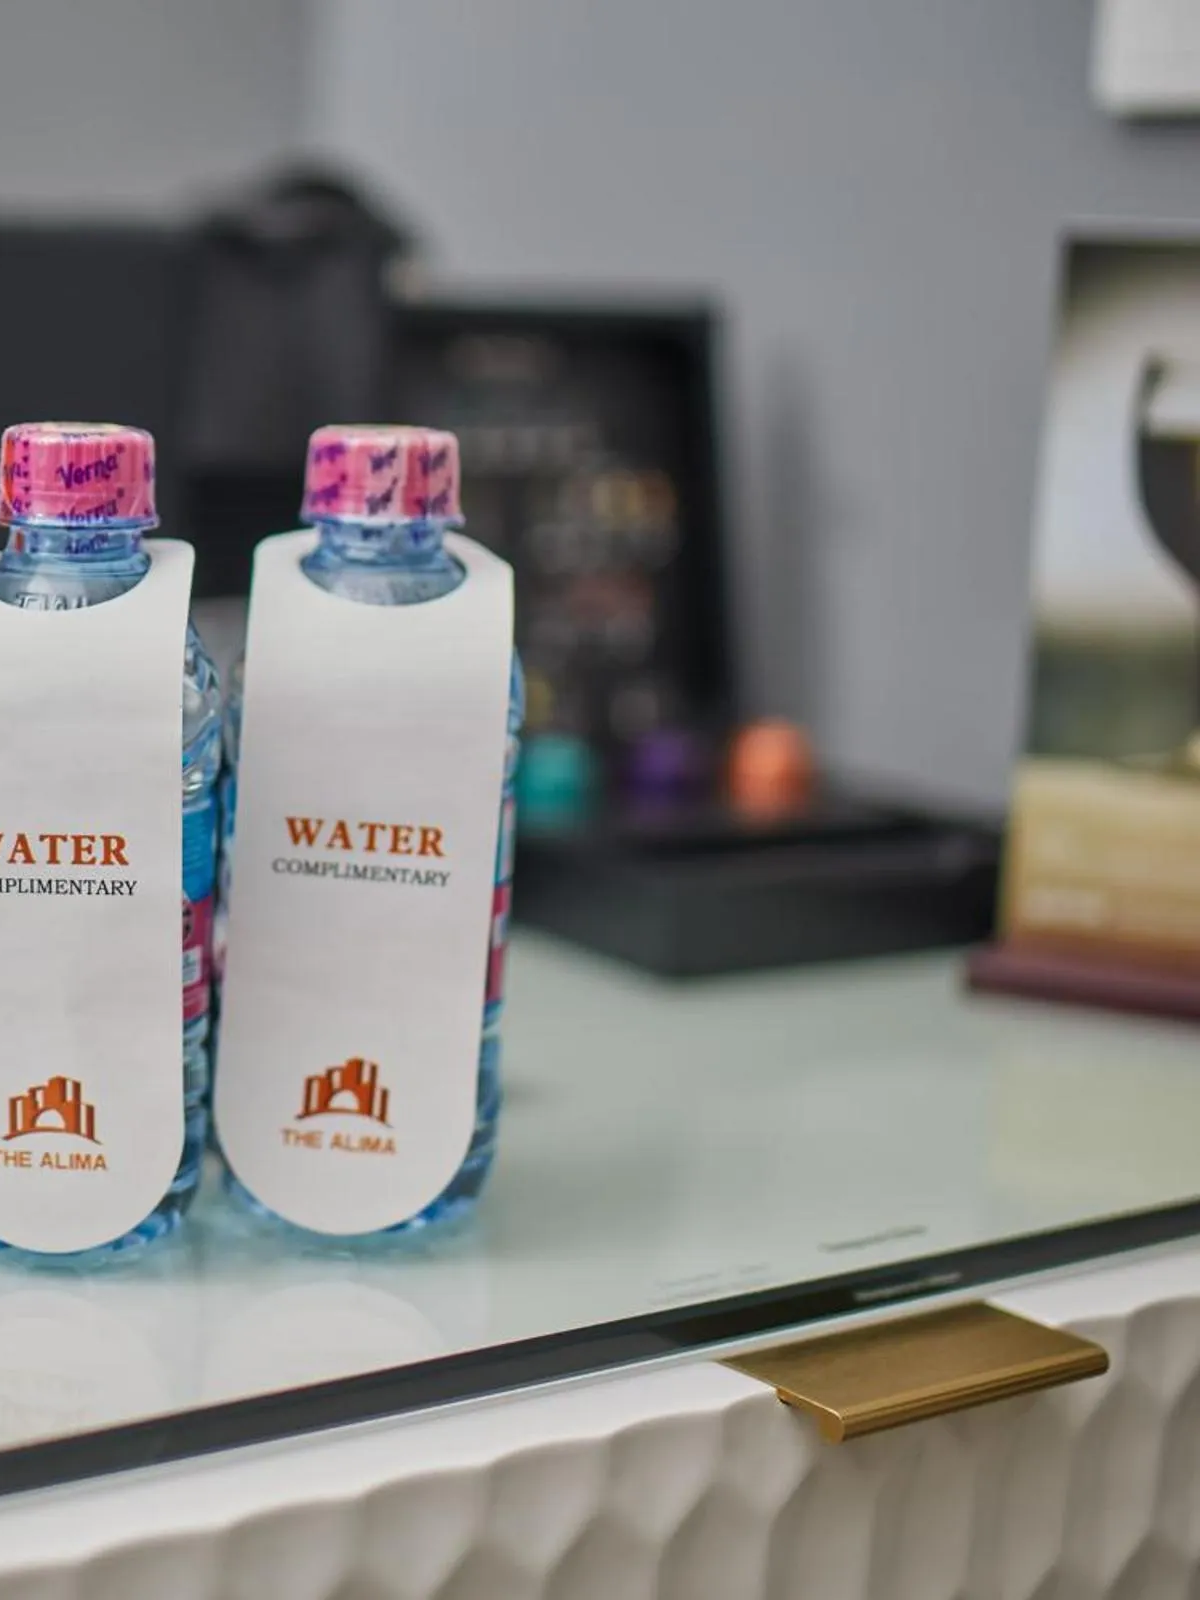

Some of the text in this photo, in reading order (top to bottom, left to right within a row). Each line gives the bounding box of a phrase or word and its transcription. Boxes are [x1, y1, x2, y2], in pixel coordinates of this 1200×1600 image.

[56, 453, 119, 489] Verna
[285, 816, 446, 857] WATER
[271, 857, 451, 888] COMPLIMENTARY
[281, 1128, 397, 1154] THE ALIMA
[40, 1151, 108, 1171] ALIMA
